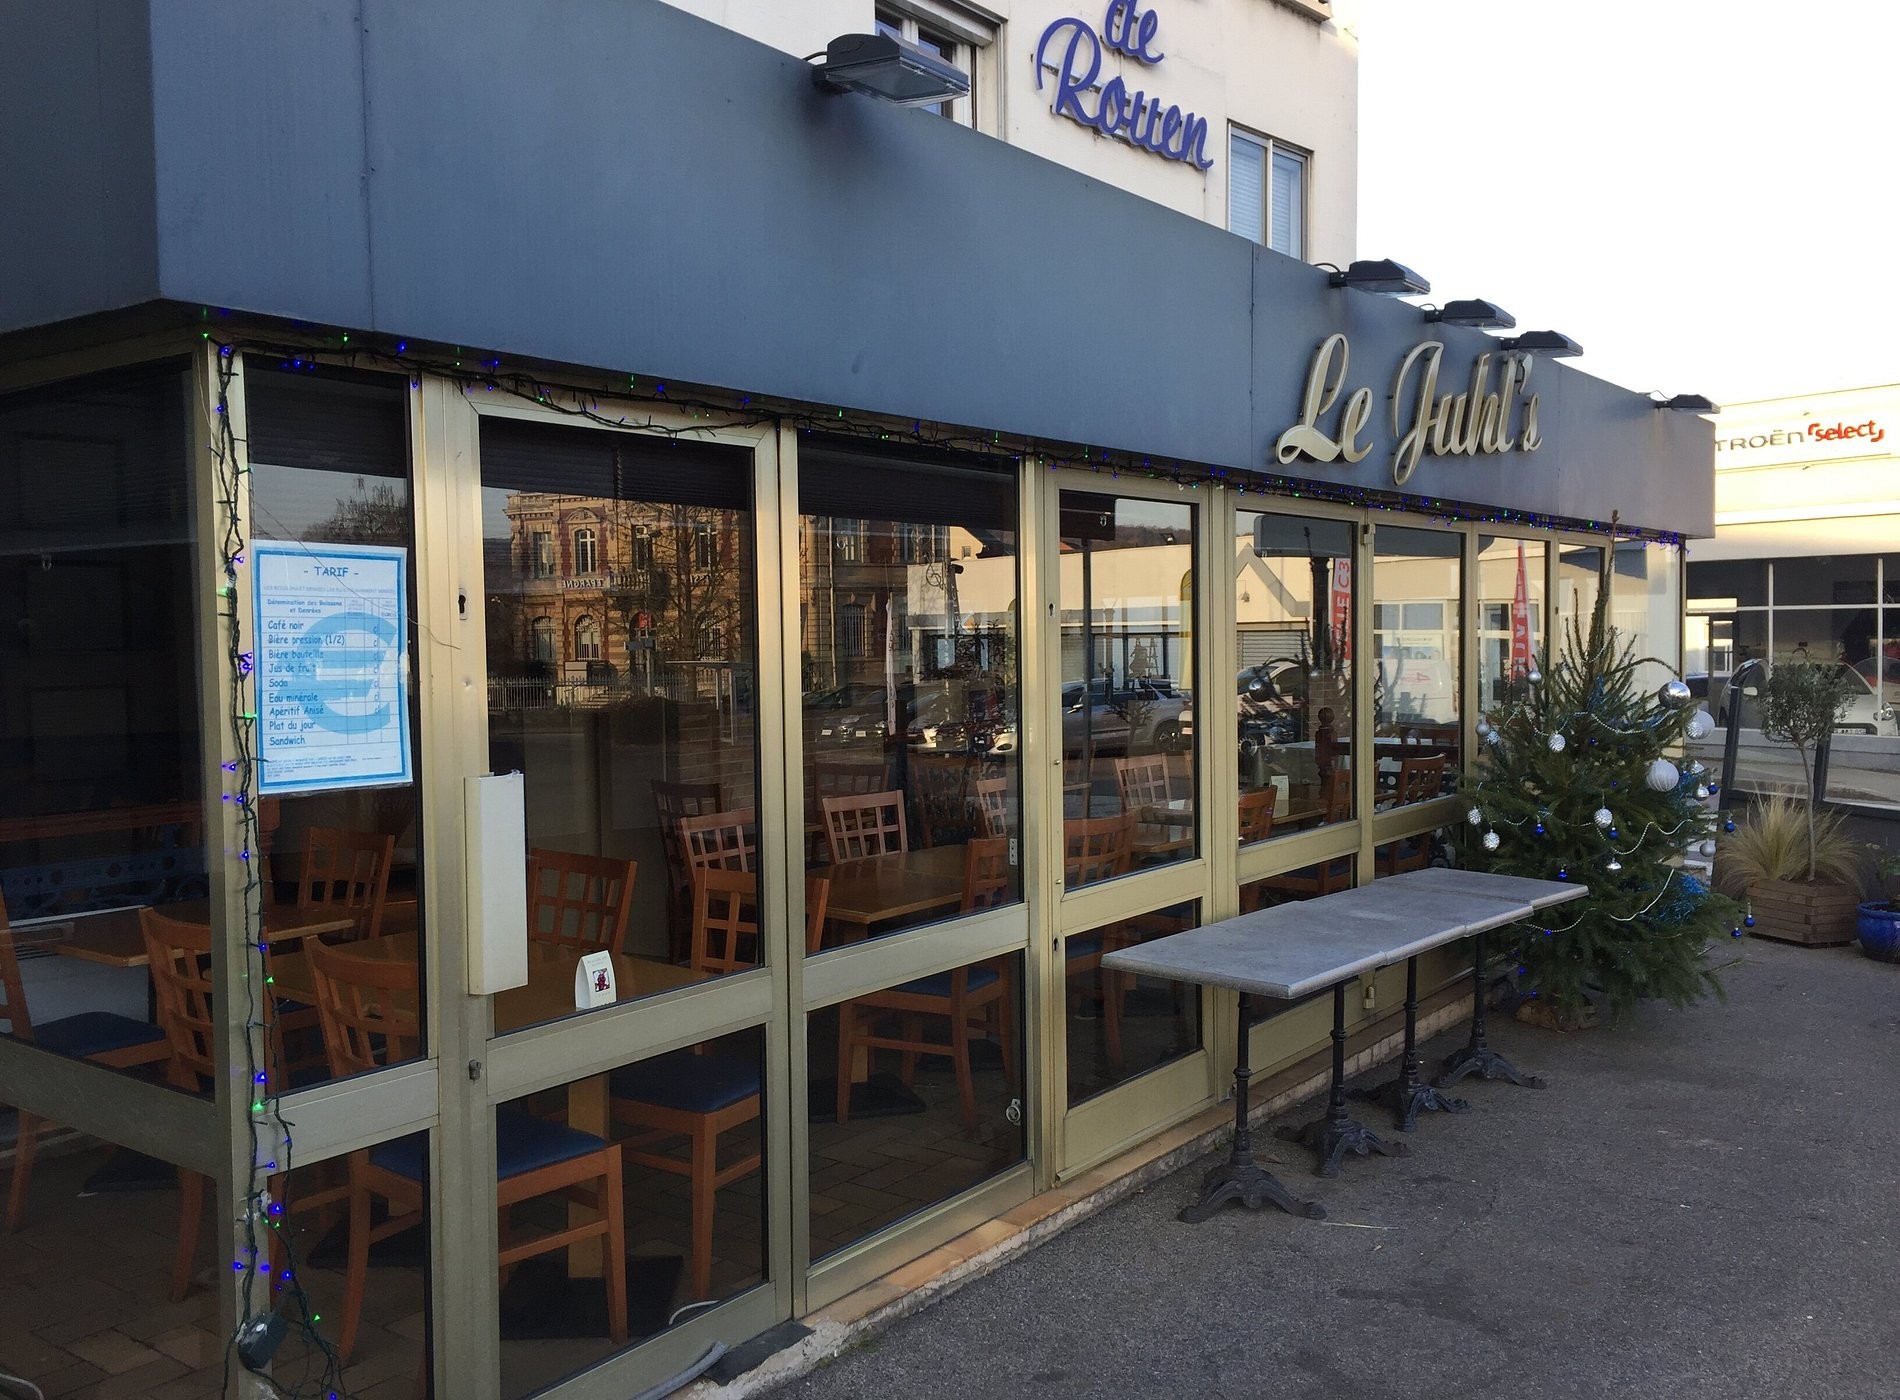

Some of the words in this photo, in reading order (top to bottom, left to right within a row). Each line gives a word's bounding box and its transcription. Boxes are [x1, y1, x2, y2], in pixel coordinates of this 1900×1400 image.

[1104, 0, 1165, 64] de
[1033, 17, 1214, 170] Rouen
[1276, 333, 1374, 464] Le
[1392, 340, 1543, 486] Juhl's
[314, 566, 349, 577] TARIF
[268, 620, 286, 630] Café
[289, 621, 304, 630] noir
[268, 634, 289, 645] Bière
[292, 634, 322, 646] pression
[325, 634, 345, 646] (1/2)
[268, 649, 289, 659] Bière
[269, 663, 283, 673] Jus
[285, 663, 295, 673] de
[298, 662, 316, 673] frut
[269, 678, 288, 688] Soda
[269, 693, 284, 703] Eau
[286, 692, 318, 702] minérale
[269, 705, 301, 718] Apéritif
[304, 704, 324, 714] Anisé
[269, 721, 285, 731] Plat
[288, 720, 298, 730] du
[300, 720, 316, 732] jour
[269, 735, 305, 746] Sandwich
